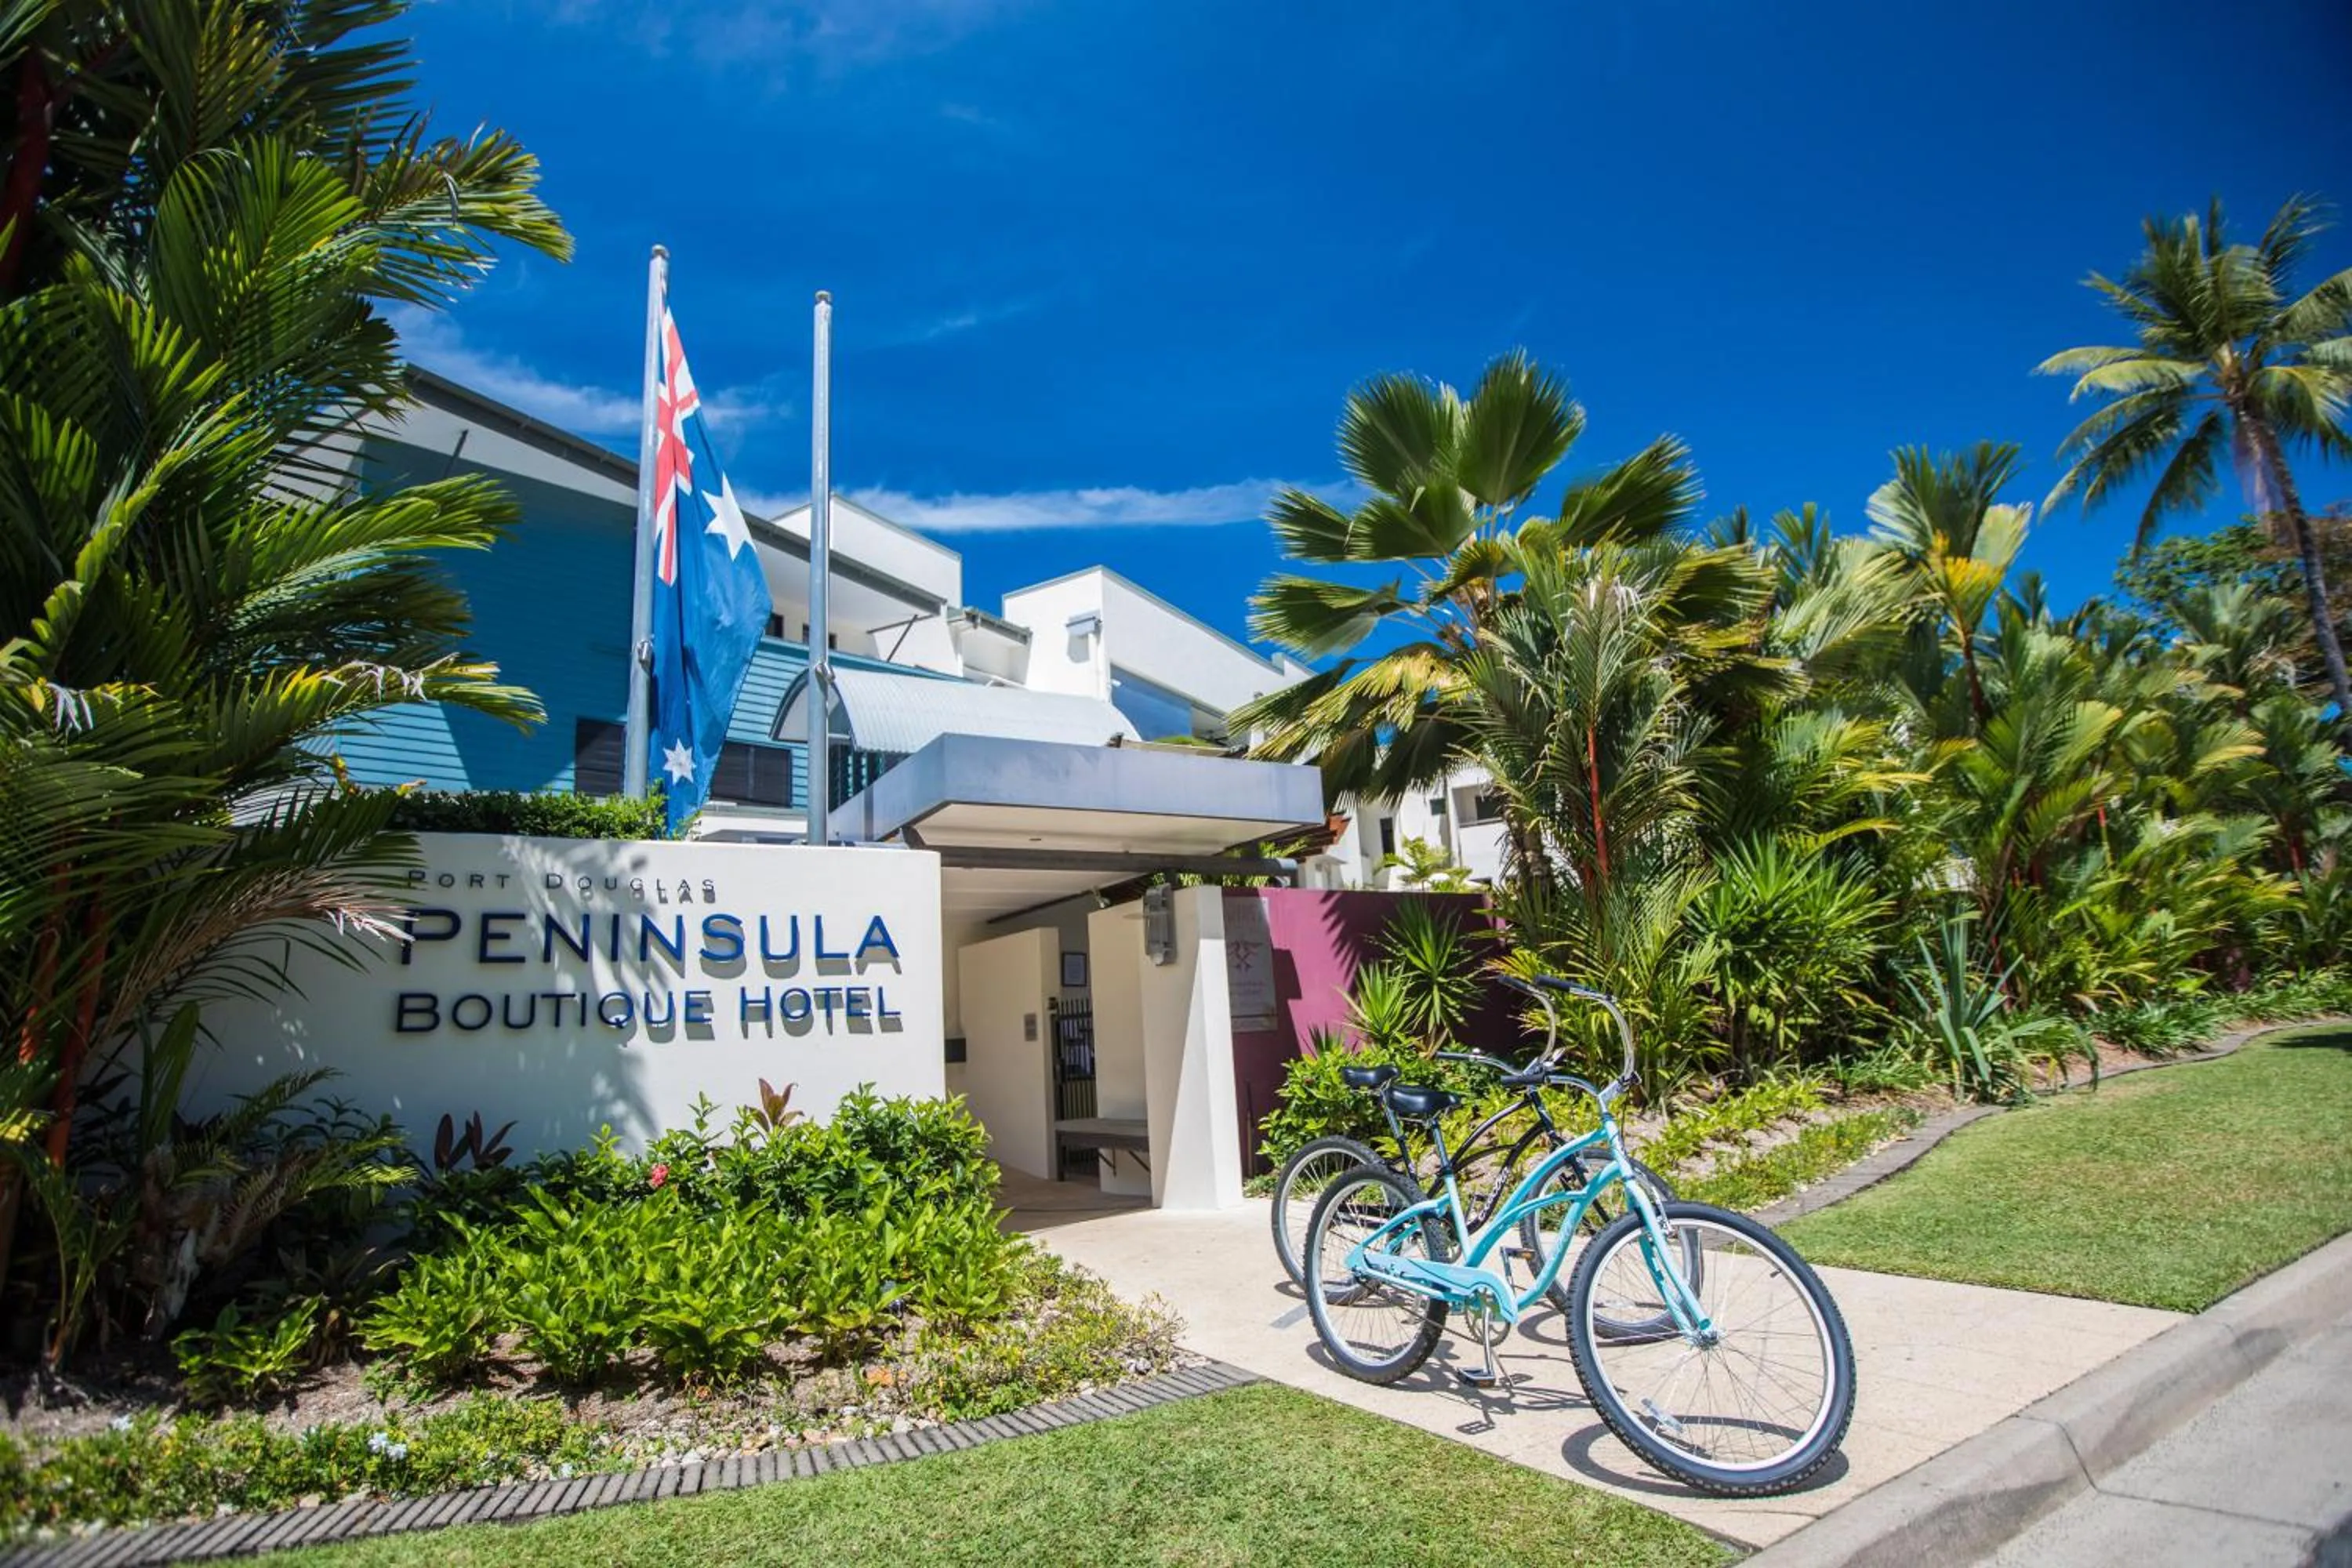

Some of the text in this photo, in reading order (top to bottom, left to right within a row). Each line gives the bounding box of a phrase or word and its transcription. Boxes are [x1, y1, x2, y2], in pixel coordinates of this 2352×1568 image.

[407, 869, 715, 892] PORT DOUGLAS
[401, 908, 900, 965] PENINSULA
[396, 985, 901, 1033] BOUTIQUE HOTEL
